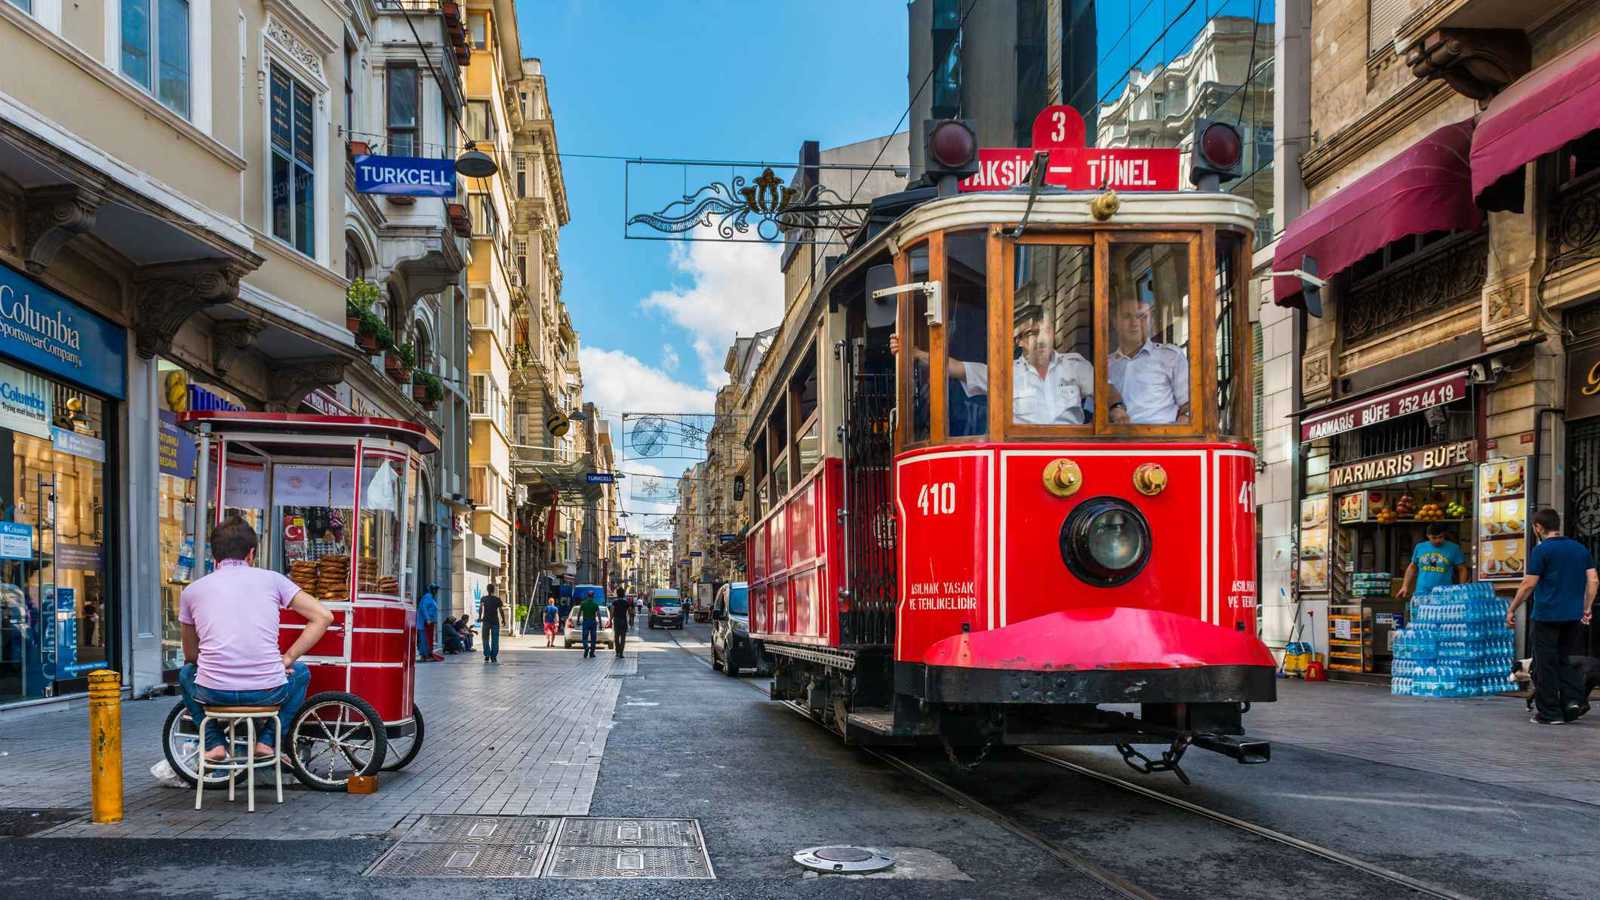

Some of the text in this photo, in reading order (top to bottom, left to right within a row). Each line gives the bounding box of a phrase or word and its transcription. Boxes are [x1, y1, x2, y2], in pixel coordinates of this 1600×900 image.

[1051, 111, 1066, 142] 3
[360, 165, 451, 186] TURKCELL
[1086, 155, 1157, 186] TÜNEL
[0, 284, 80, 350] Columbia
[1, 382, 46, 412] Columbia
[1309, 385, 1453, 439] MARMARİS BÜFE 252 44 19
[917, 482, 956, 516] 410
[1238, 480, 1256, 513] 41
[911, 581, 974, 595] ASILMAK YASAK
[918, 595, 977, 610] TEHLİKELİDİR
[1227, 595, 1239, 608] VE
